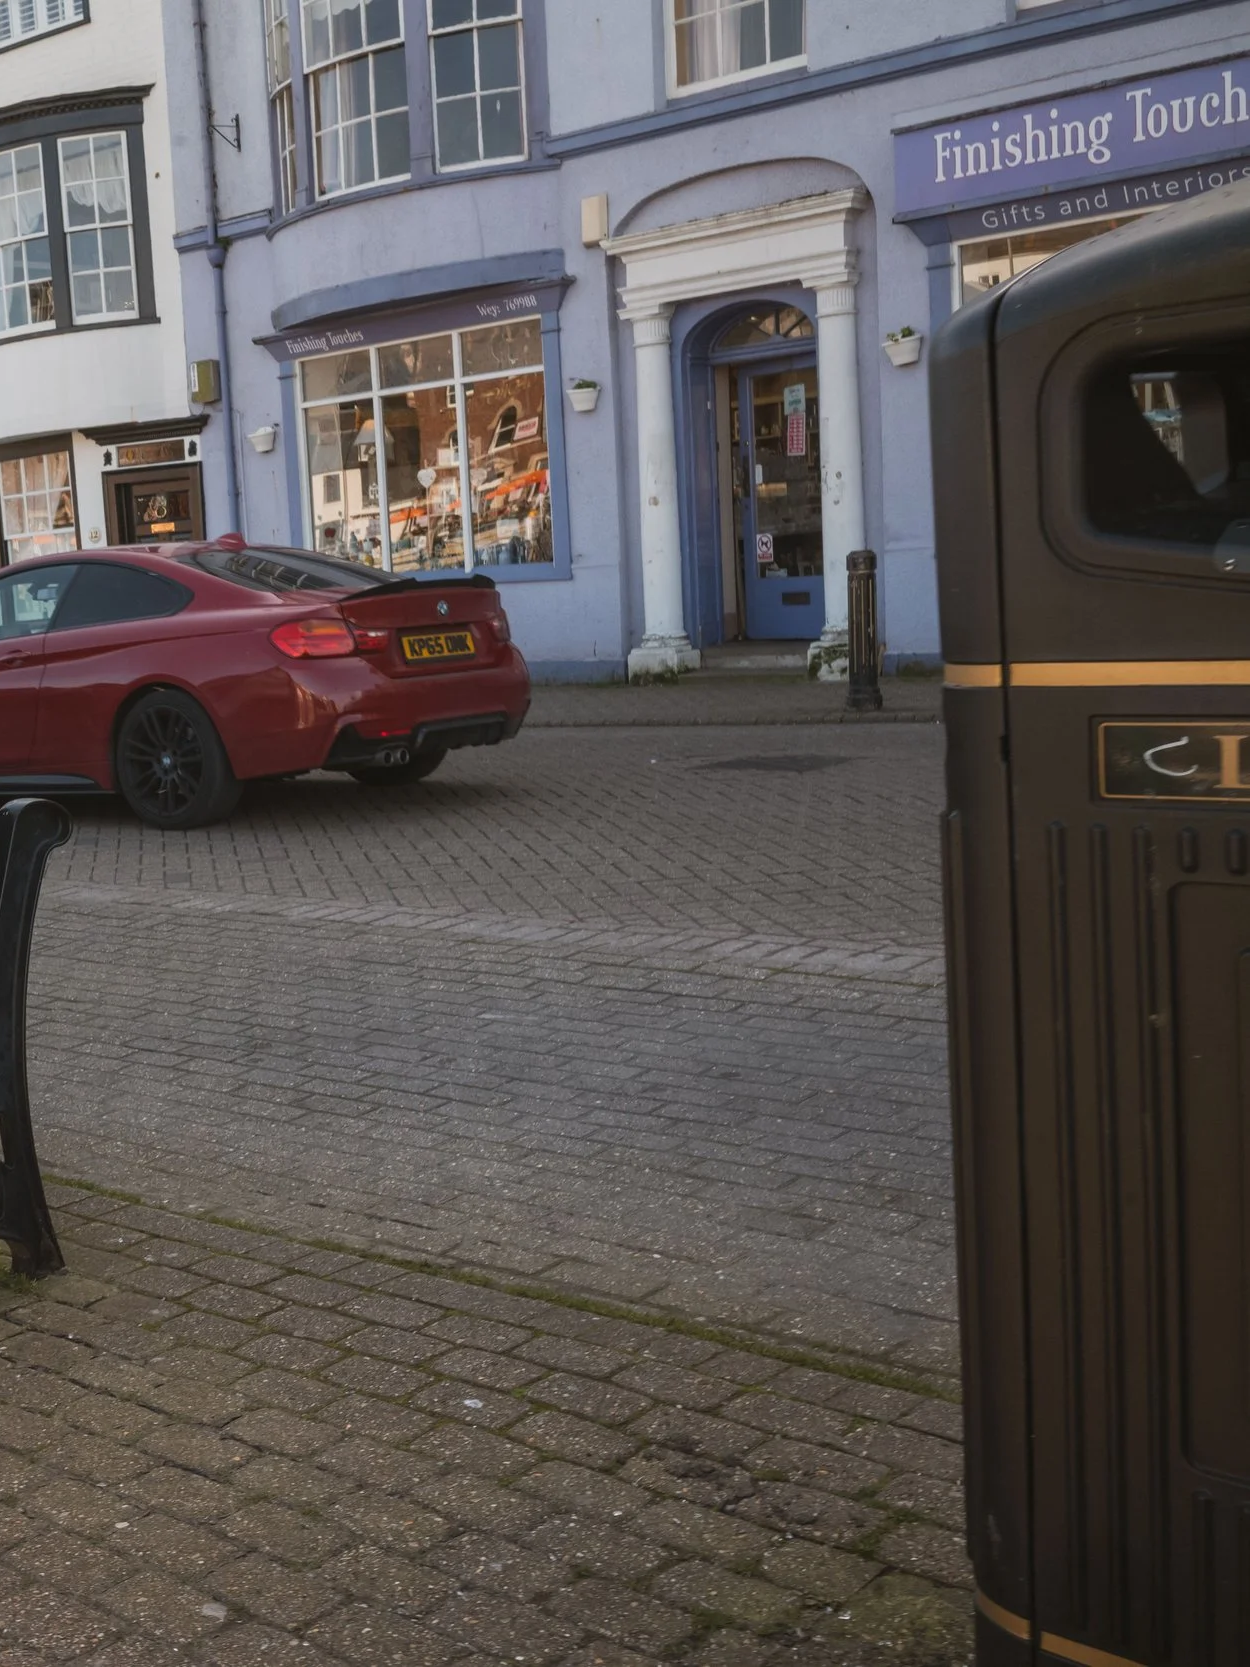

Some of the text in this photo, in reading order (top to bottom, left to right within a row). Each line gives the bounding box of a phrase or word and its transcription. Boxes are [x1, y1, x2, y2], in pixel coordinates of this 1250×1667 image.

[934, 70, 1250, 184] Finishing Touch
[981, 198, 1046, 229] Gifts
[1058, 189, 1110, 217] and
[476, 294, 538, 318] Wey: 769988
[285, 328, 364, 354] Finishing Touches
[407, 636, 444, 657] KP65
